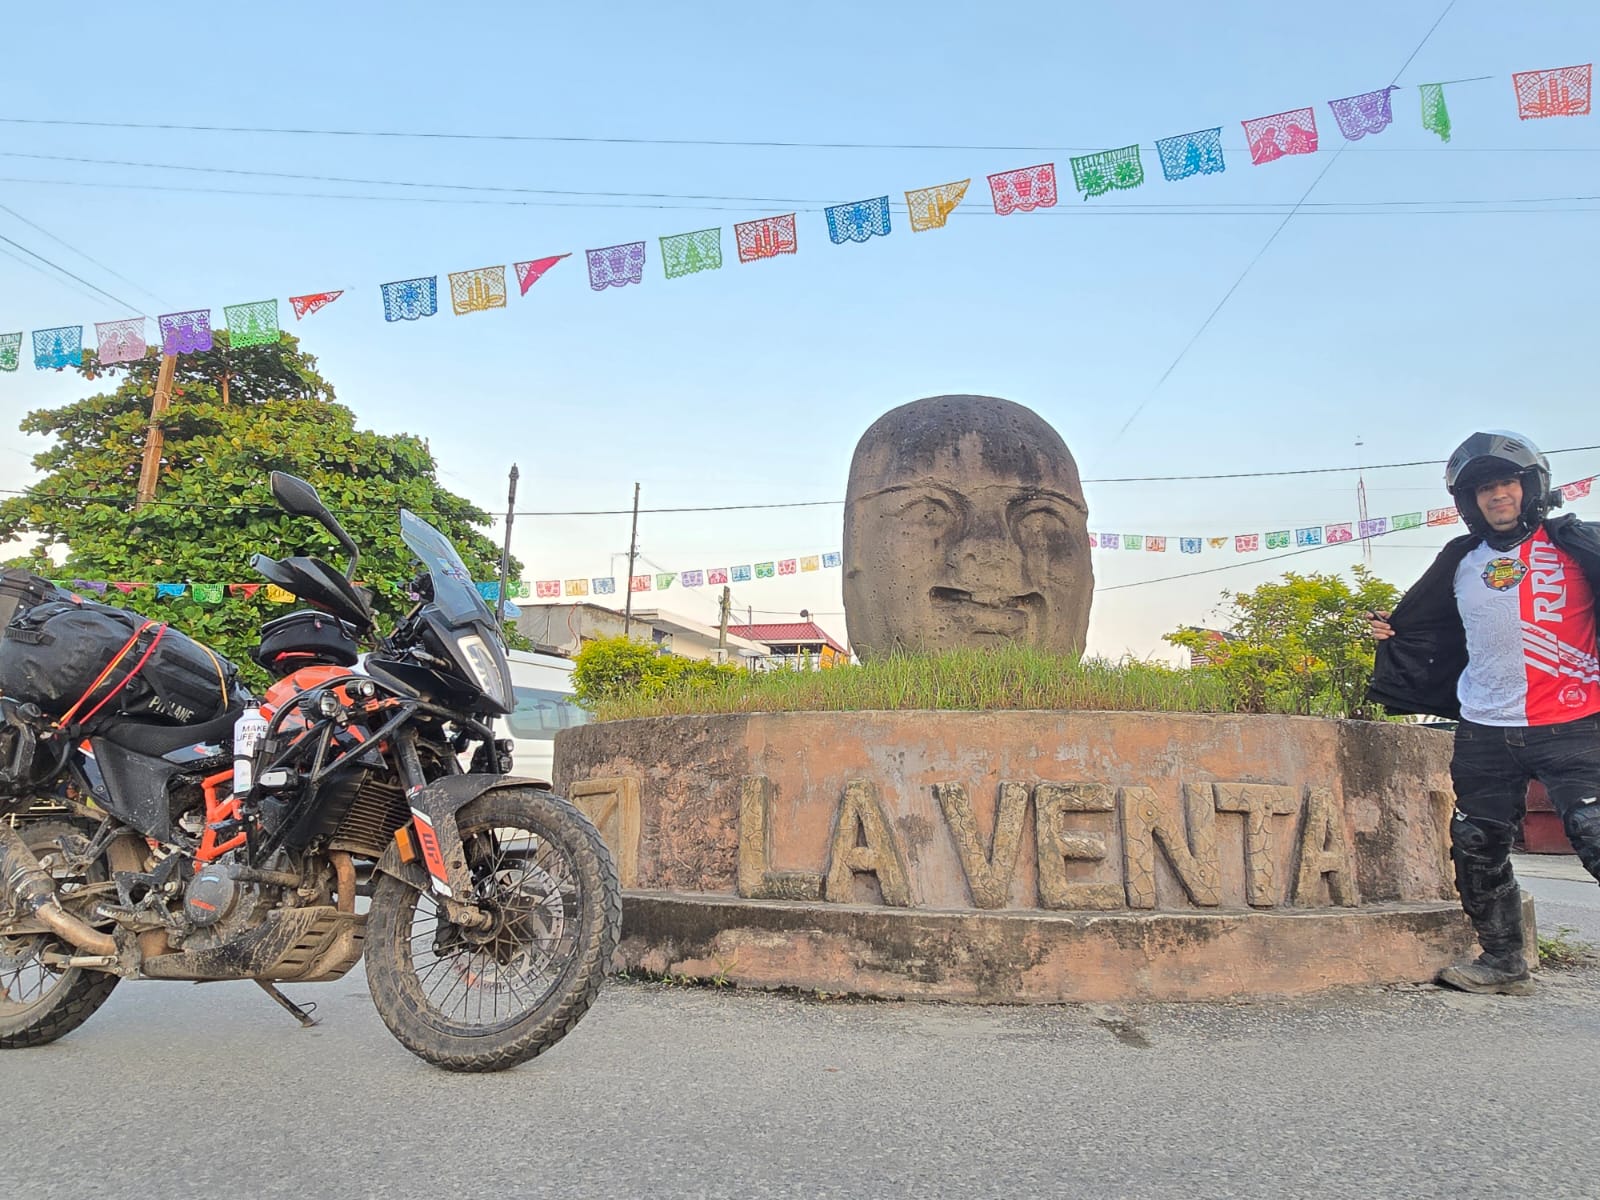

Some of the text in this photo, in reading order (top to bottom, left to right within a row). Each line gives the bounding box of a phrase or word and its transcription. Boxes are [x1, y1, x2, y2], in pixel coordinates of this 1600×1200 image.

[242, 725, 267, 733] MAKE
[738, 774, 1361, 910] LA VENTA
